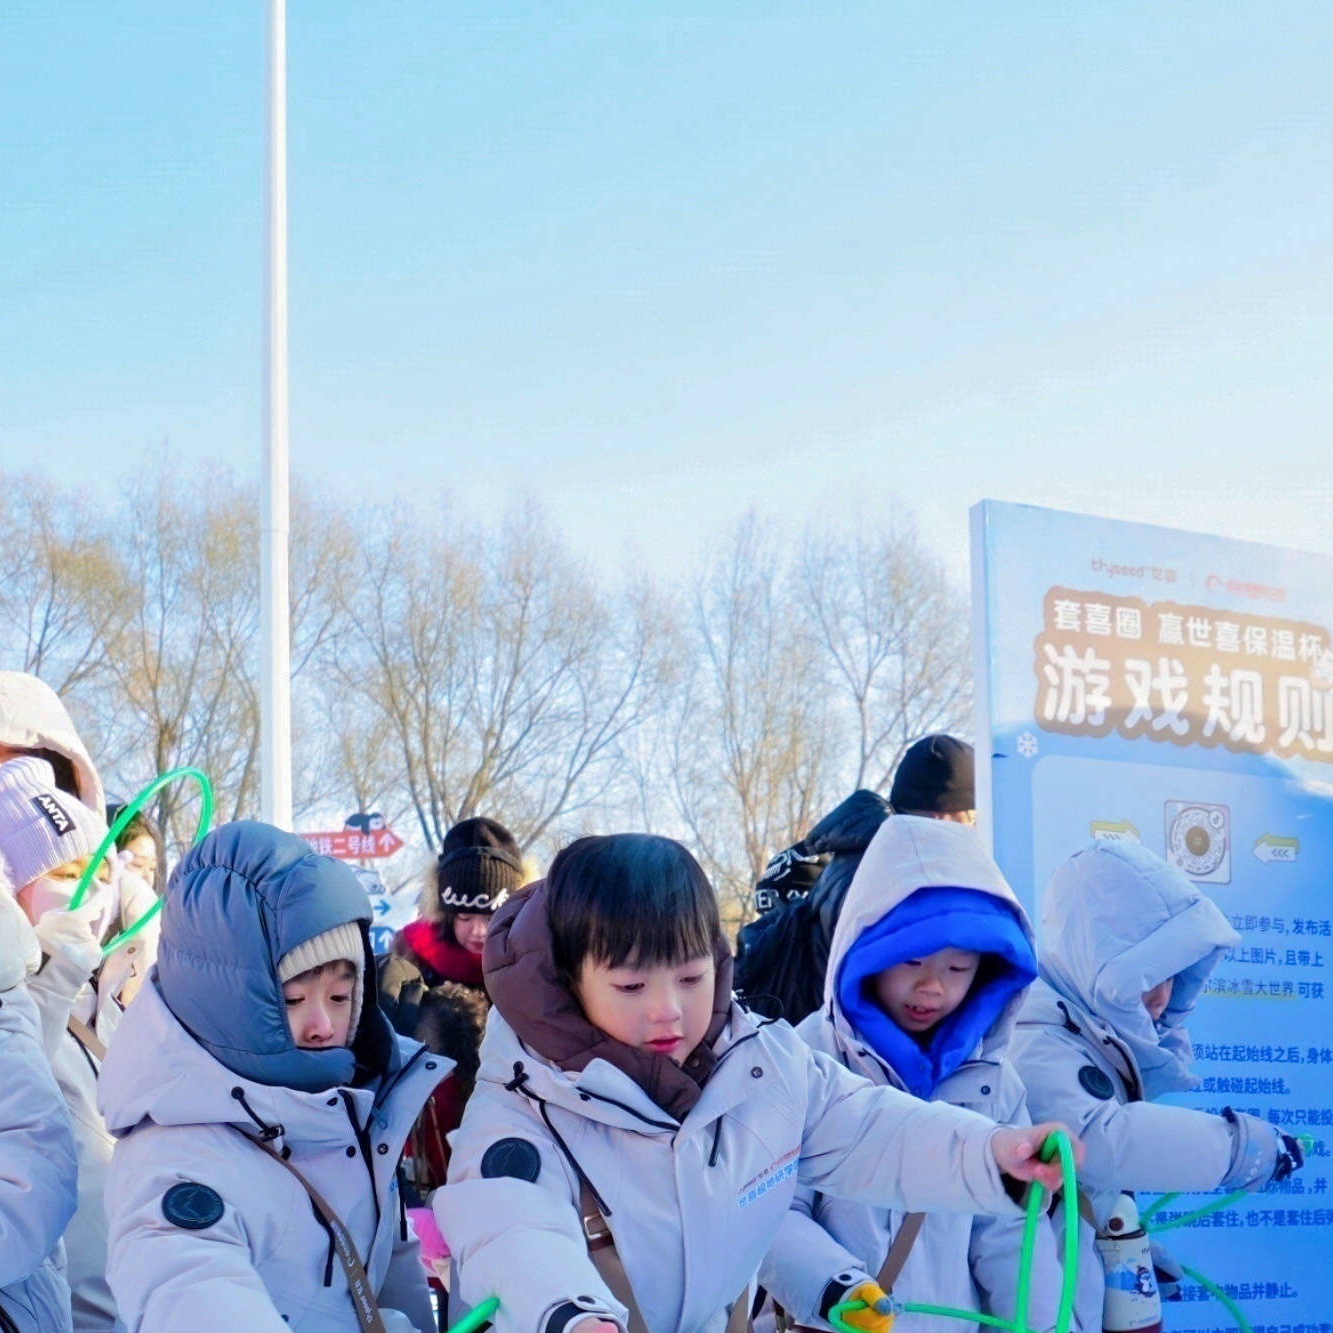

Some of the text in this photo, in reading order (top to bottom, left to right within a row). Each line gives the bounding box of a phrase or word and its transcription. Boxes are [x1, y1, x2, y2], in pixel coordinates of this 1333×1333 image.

[1053, 599, 1324, 664] 套喜圈 赢世喜保温杯
[37, 797, 69, 832] ANTA
[1225, 914, 1332, 937] 立即参与，发布活
